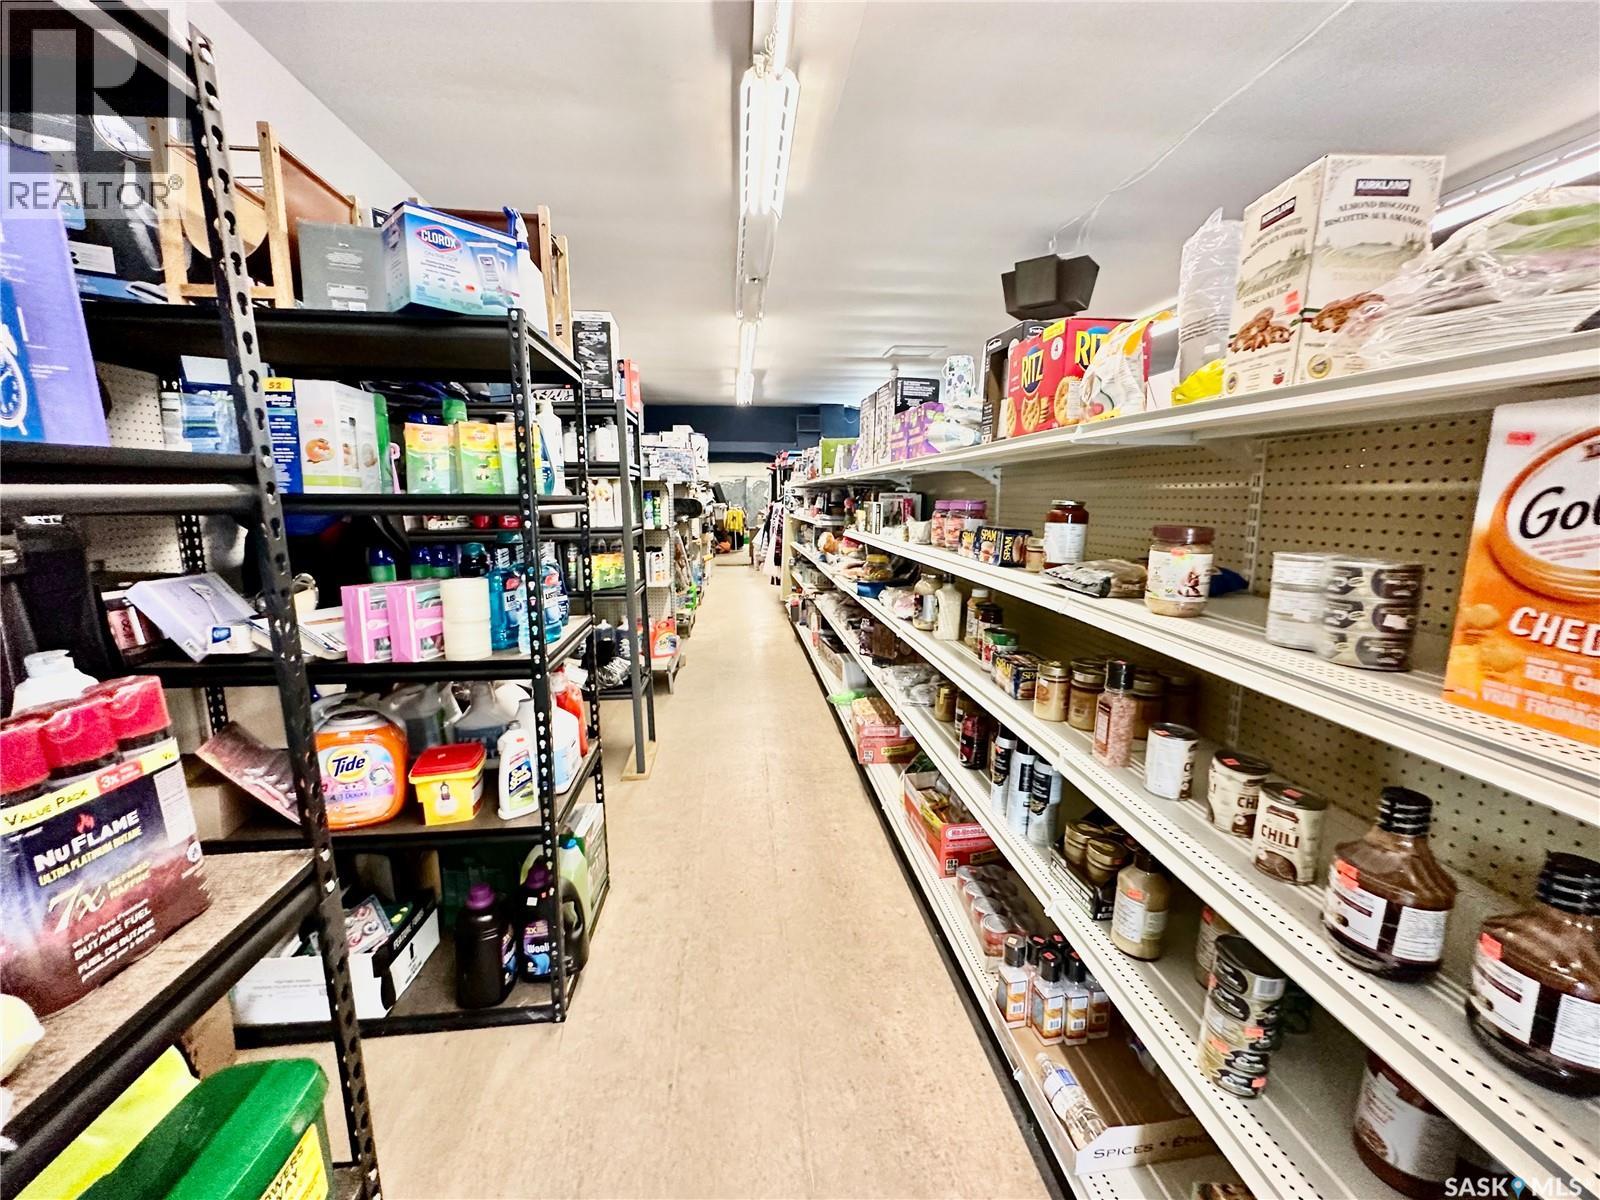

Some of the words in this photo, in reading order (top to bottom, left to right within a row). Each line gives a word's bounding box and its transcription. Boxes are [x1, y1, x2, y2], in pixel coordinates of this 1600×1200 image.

[1357, 180, 1410, 190] KIRKLAND
[420, 229, 457, 249] CLOROX
[1021, 349, 1044, 389] RITZ
[981, 528, 997, 542] SPAM
[1003, 536, 1013, 561] SPAM
[331, 755, 366, 778] Tide
[1260, 823, 1300, 849] CHILI
[74, 923, 123, 961] BUTANE
[123, 907, 152, 929] FUEL
[77, 952, 104, 975] FUEL
[104, 942, 119, 957] DE
[1093, 1143, 1154, 1159] SPICES
